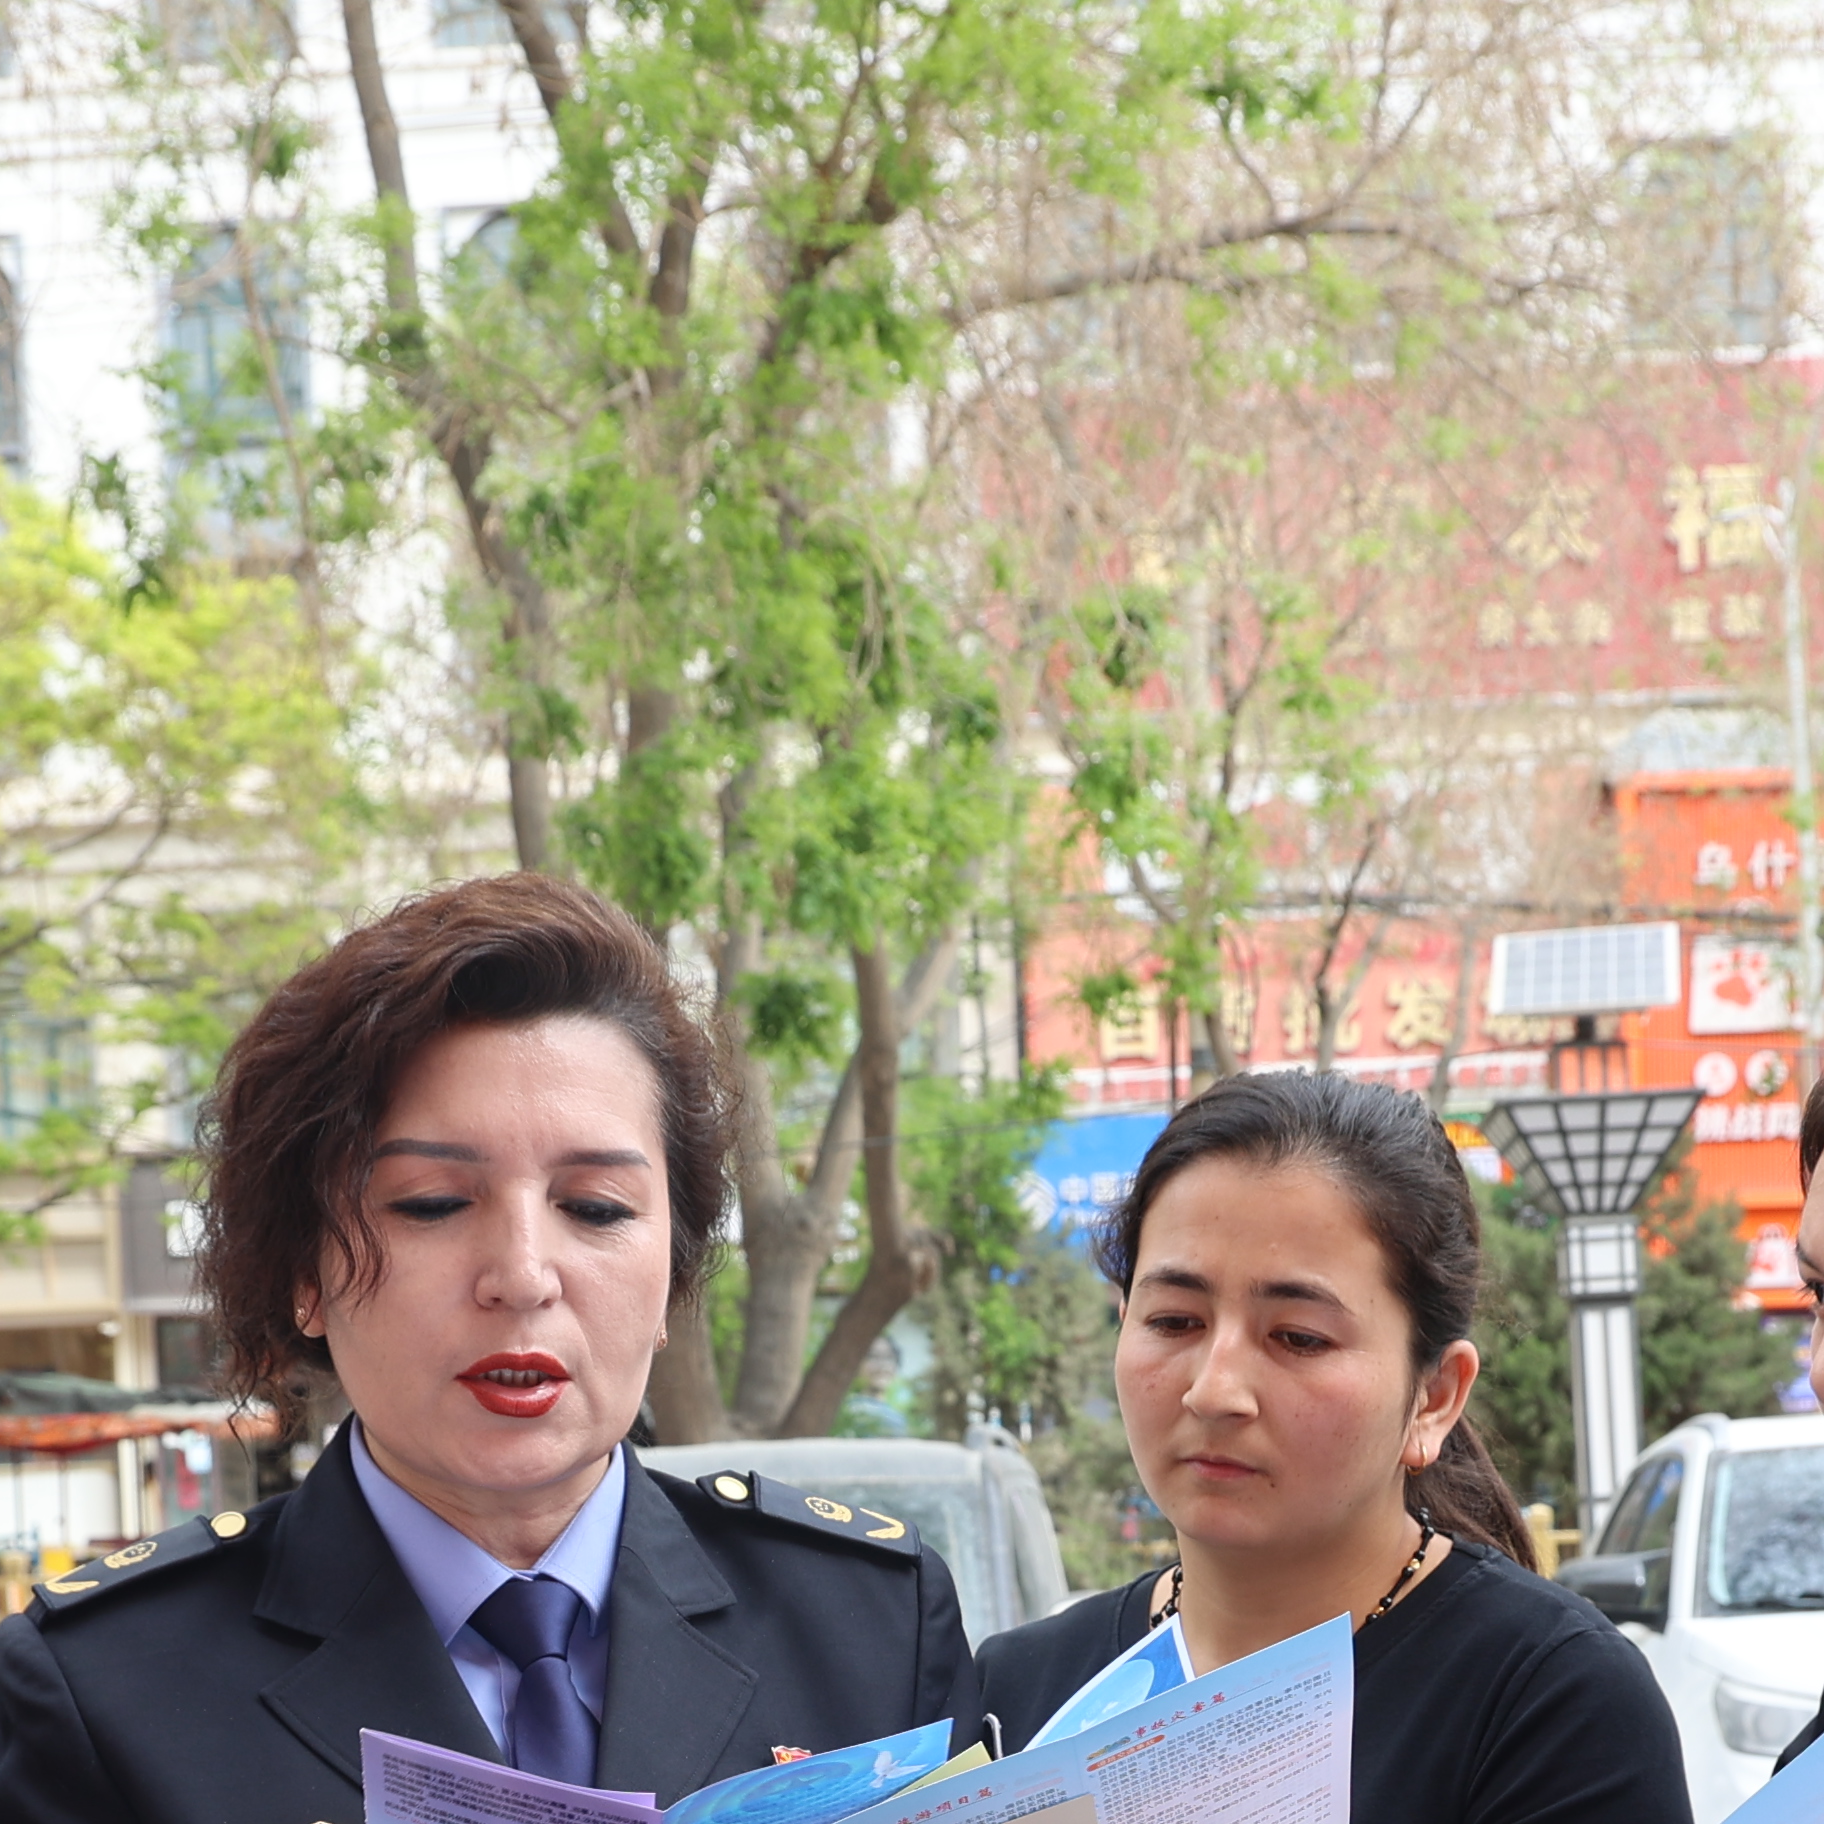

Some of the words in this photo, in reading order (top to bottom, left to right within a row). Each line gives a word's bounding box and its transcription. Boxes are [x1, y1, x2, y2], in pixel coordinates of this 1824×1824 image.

[1131, 1690, 1226, 1741] 事故灾害篇
